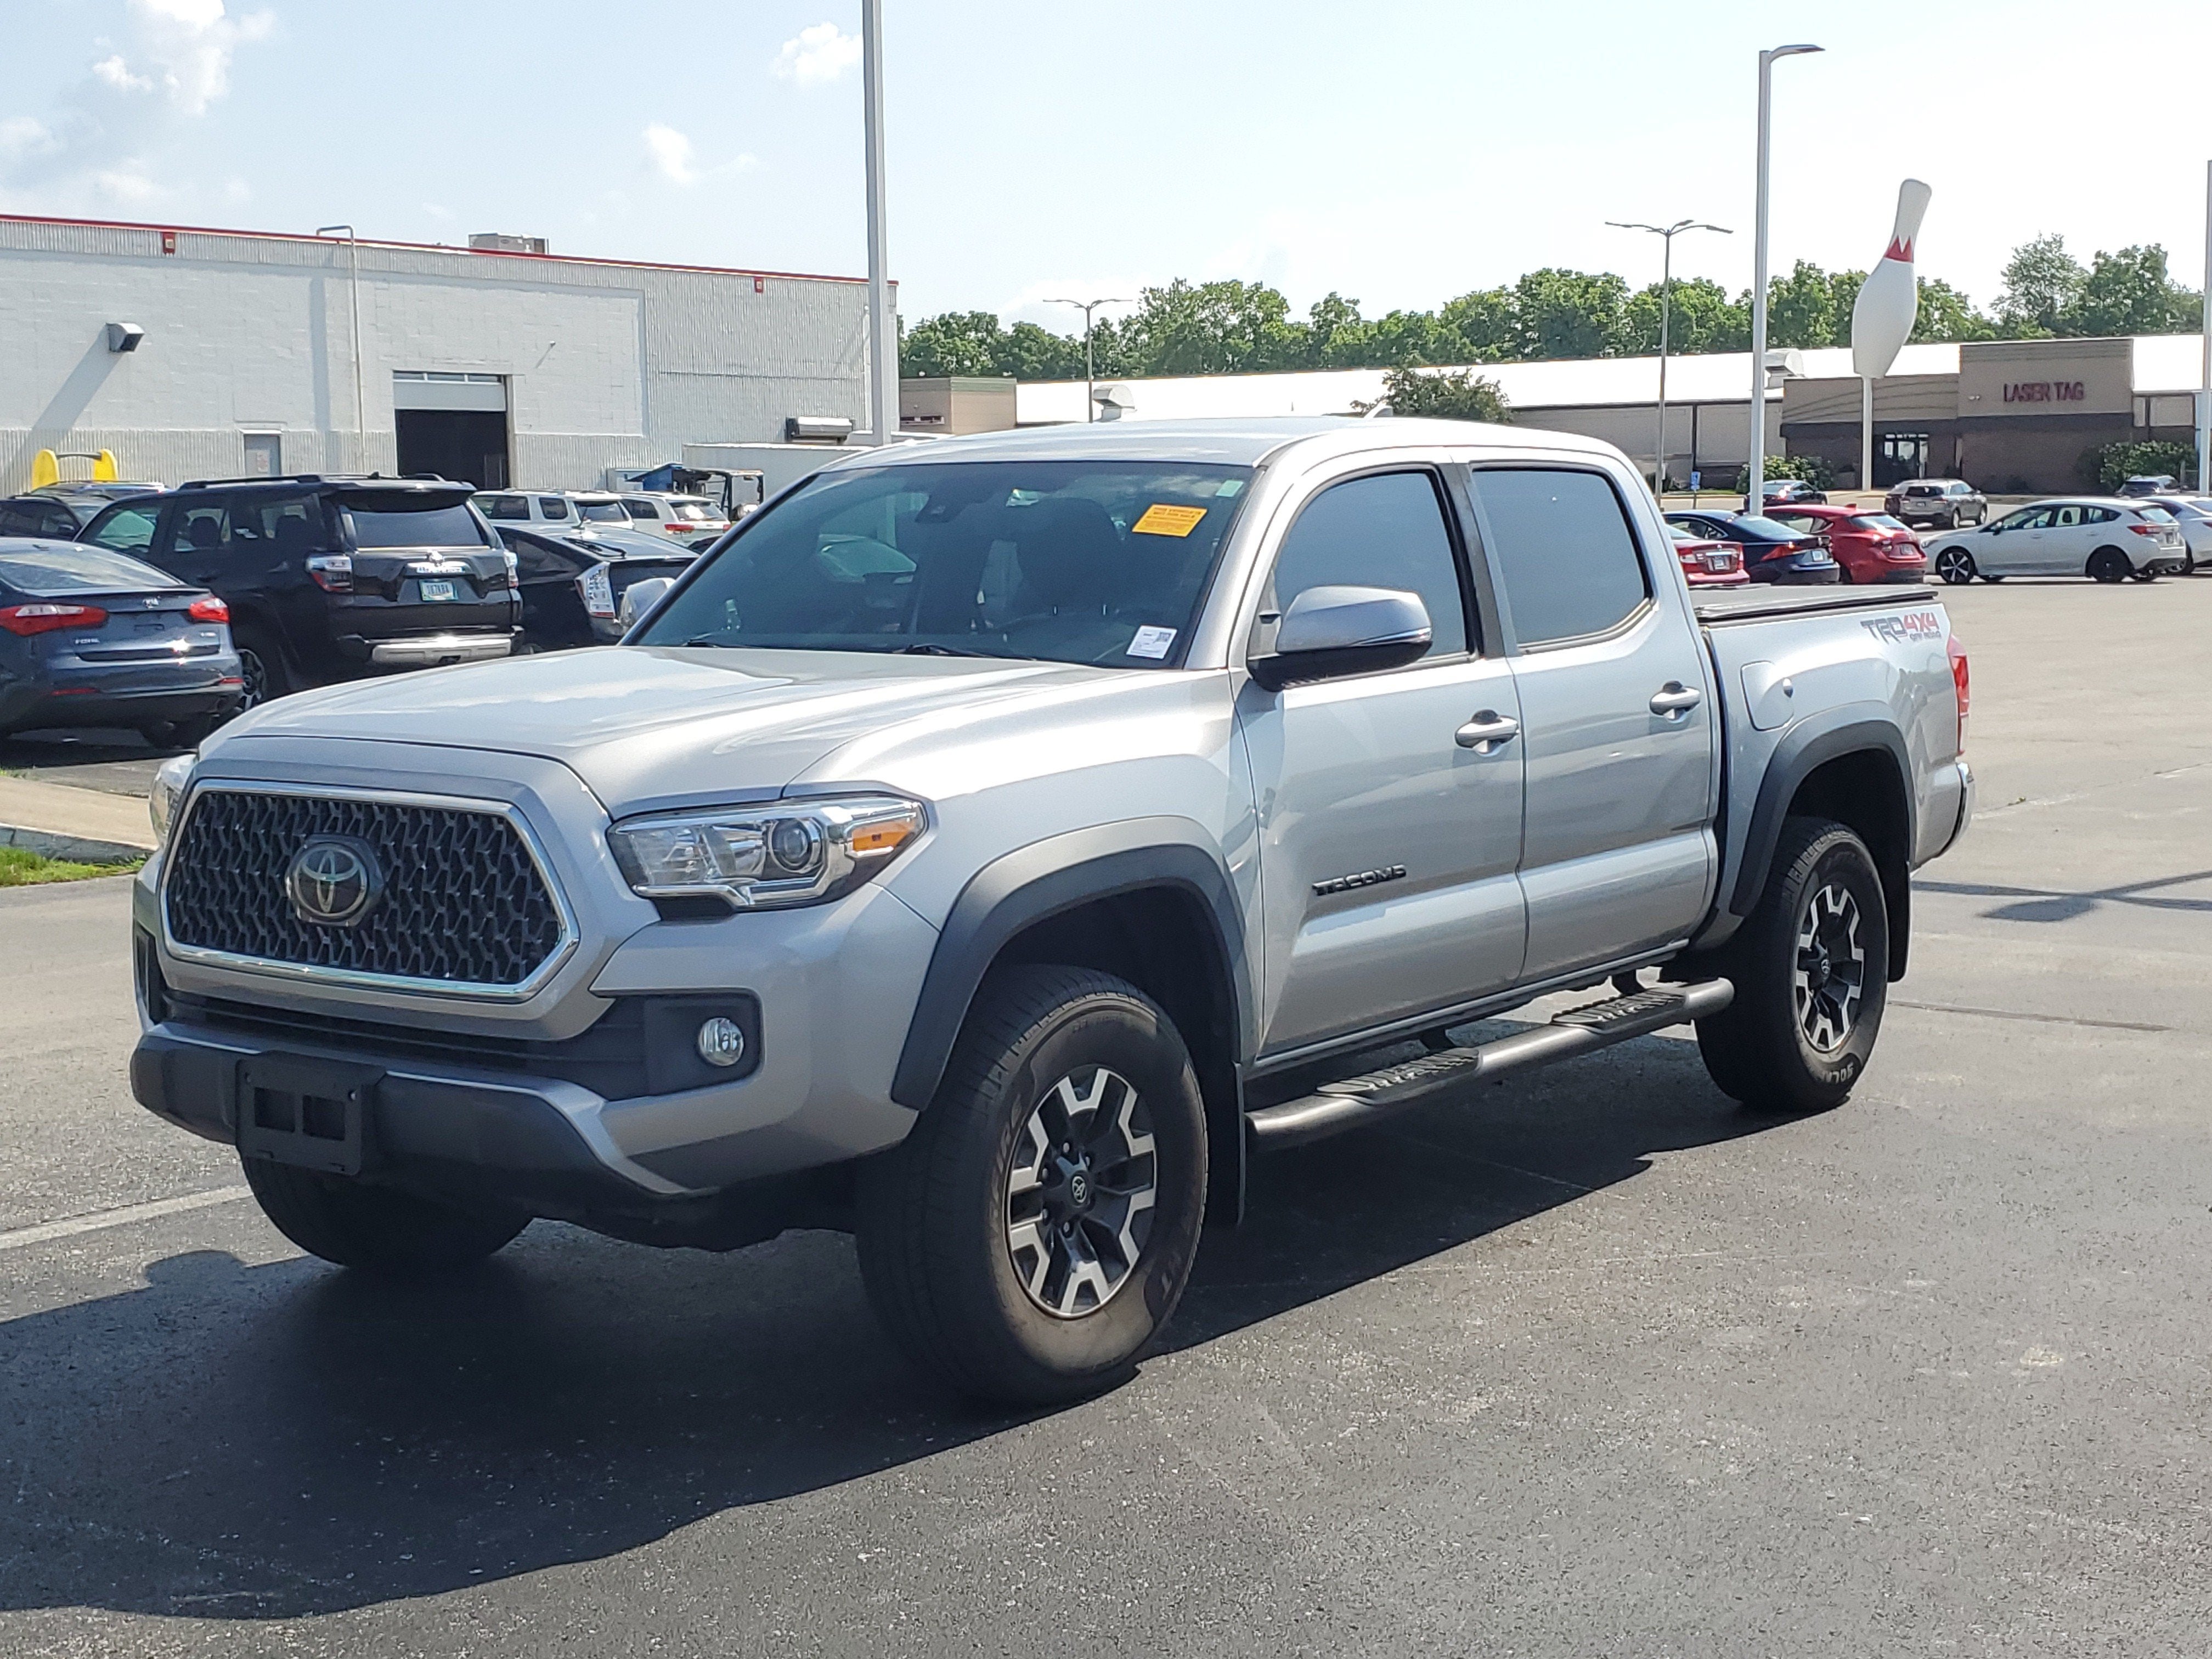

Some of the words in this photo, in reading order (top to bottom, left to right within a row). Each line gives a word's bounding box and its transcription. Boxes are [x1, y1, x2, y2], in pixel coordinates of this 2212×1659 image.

[2004, 383, 2051, 402] LASER
[2053, 381, 2084, 401] TAG
[1860, 616, 1908, 645] TRD
[1312, 864, 1407, 896] TACOMA
